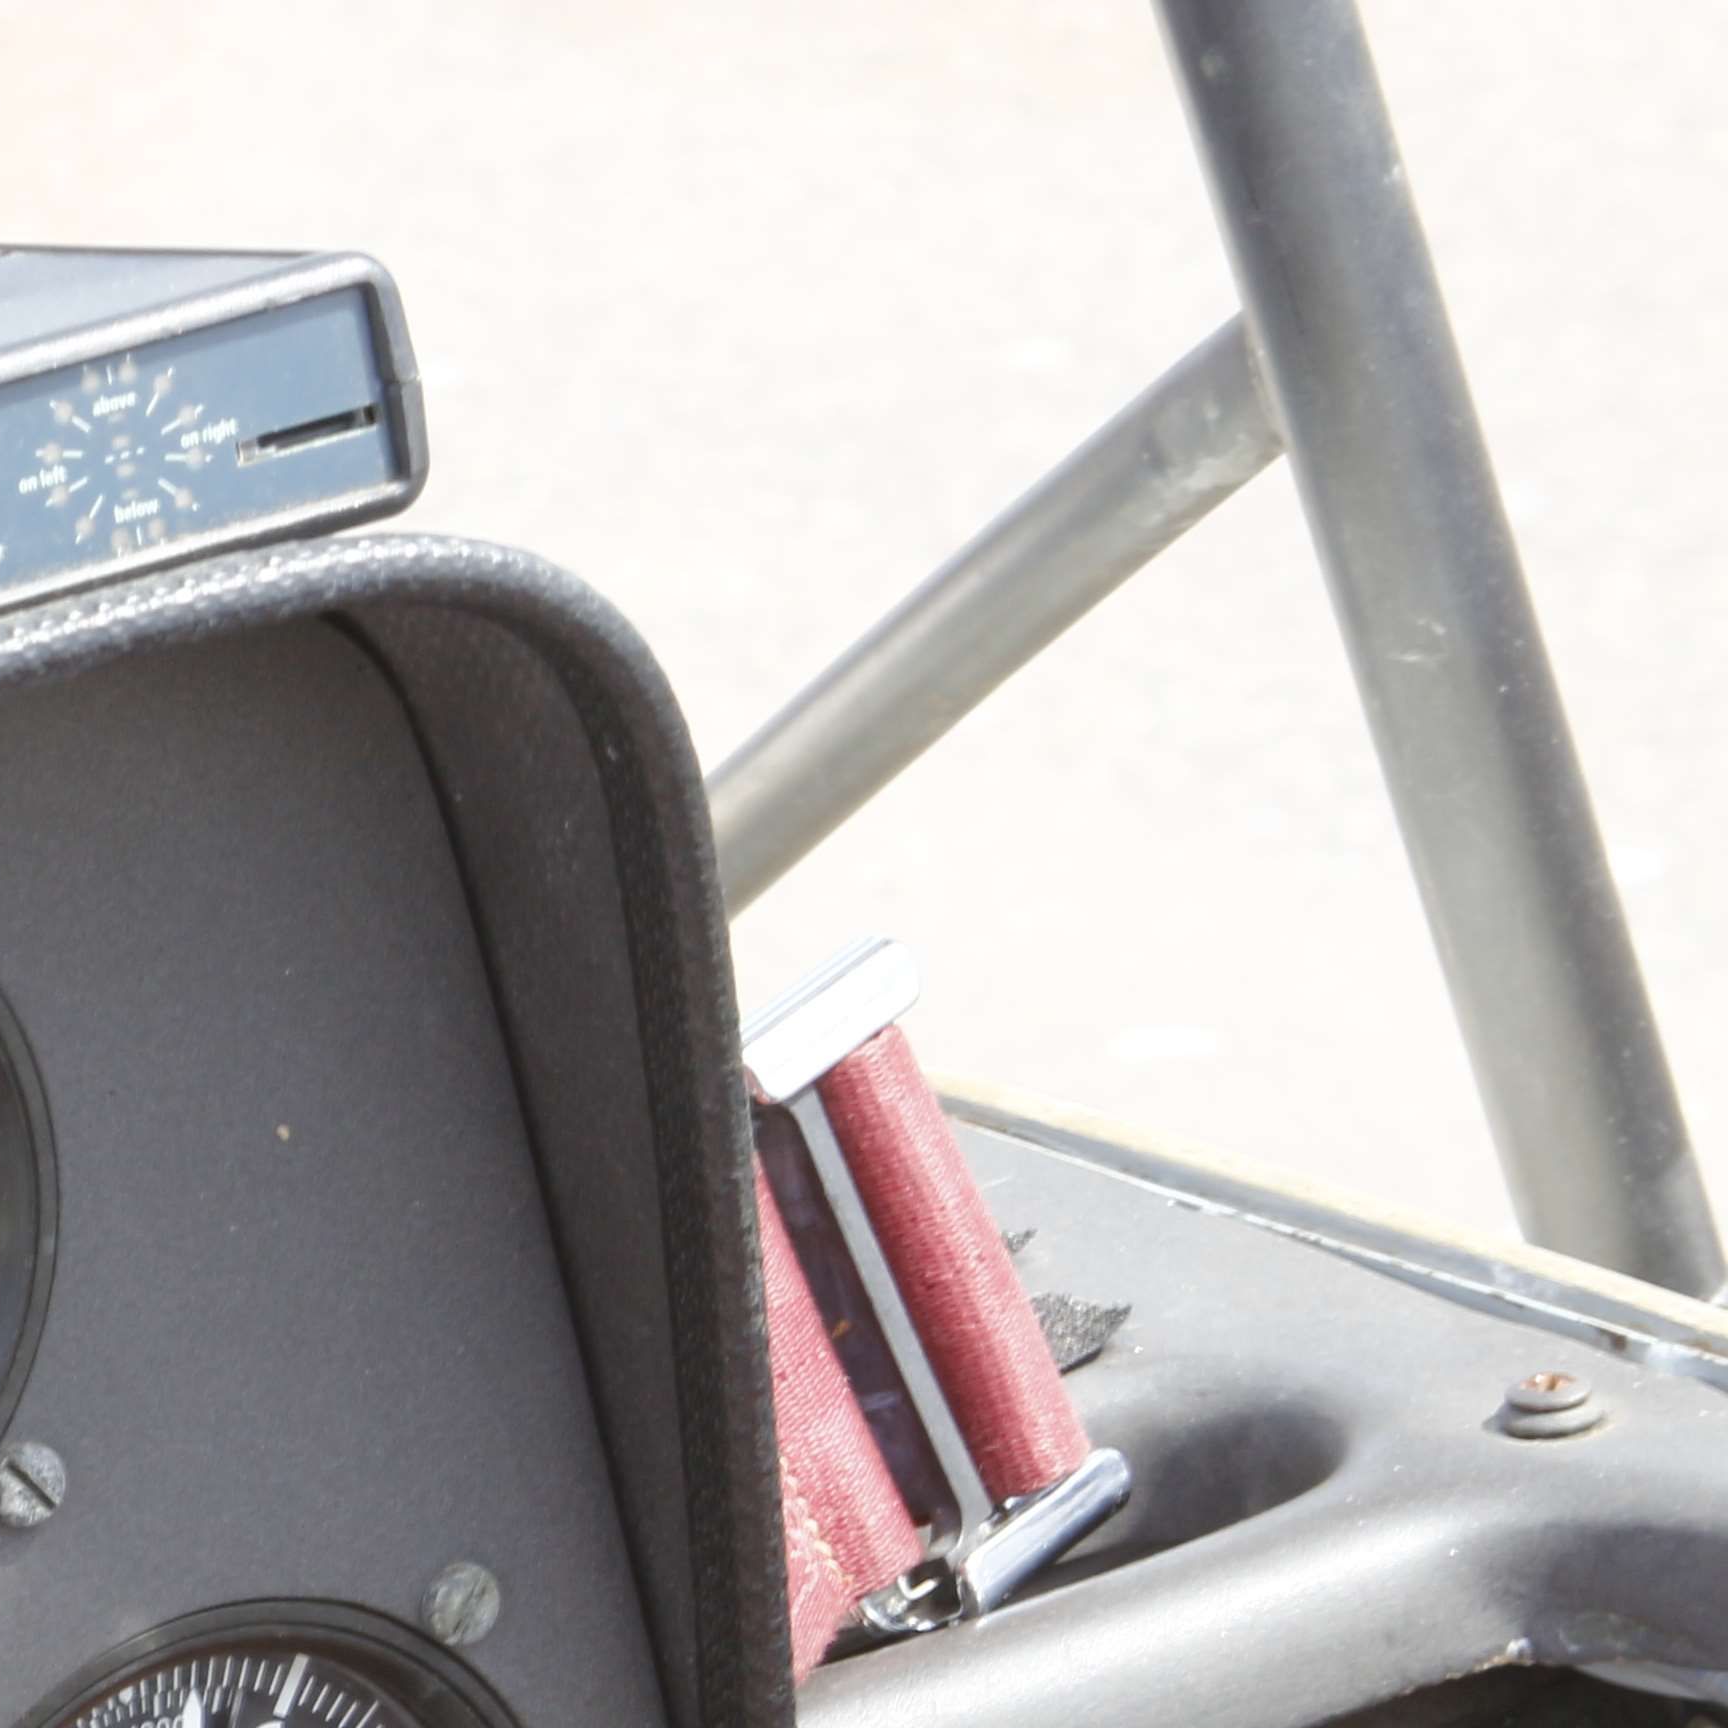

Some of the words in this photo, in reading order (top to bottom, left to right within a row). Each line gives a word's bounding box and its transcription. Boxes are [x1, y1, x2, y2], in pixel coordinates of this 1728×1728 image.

[93, 391, 136, 418] above
[181, 431, 200, 449] on
[202, 417, 238, 445] right
[18, 475, 38, 495] on
[39, 464, 67, 488] left
[113, 499, 160, 524] below
